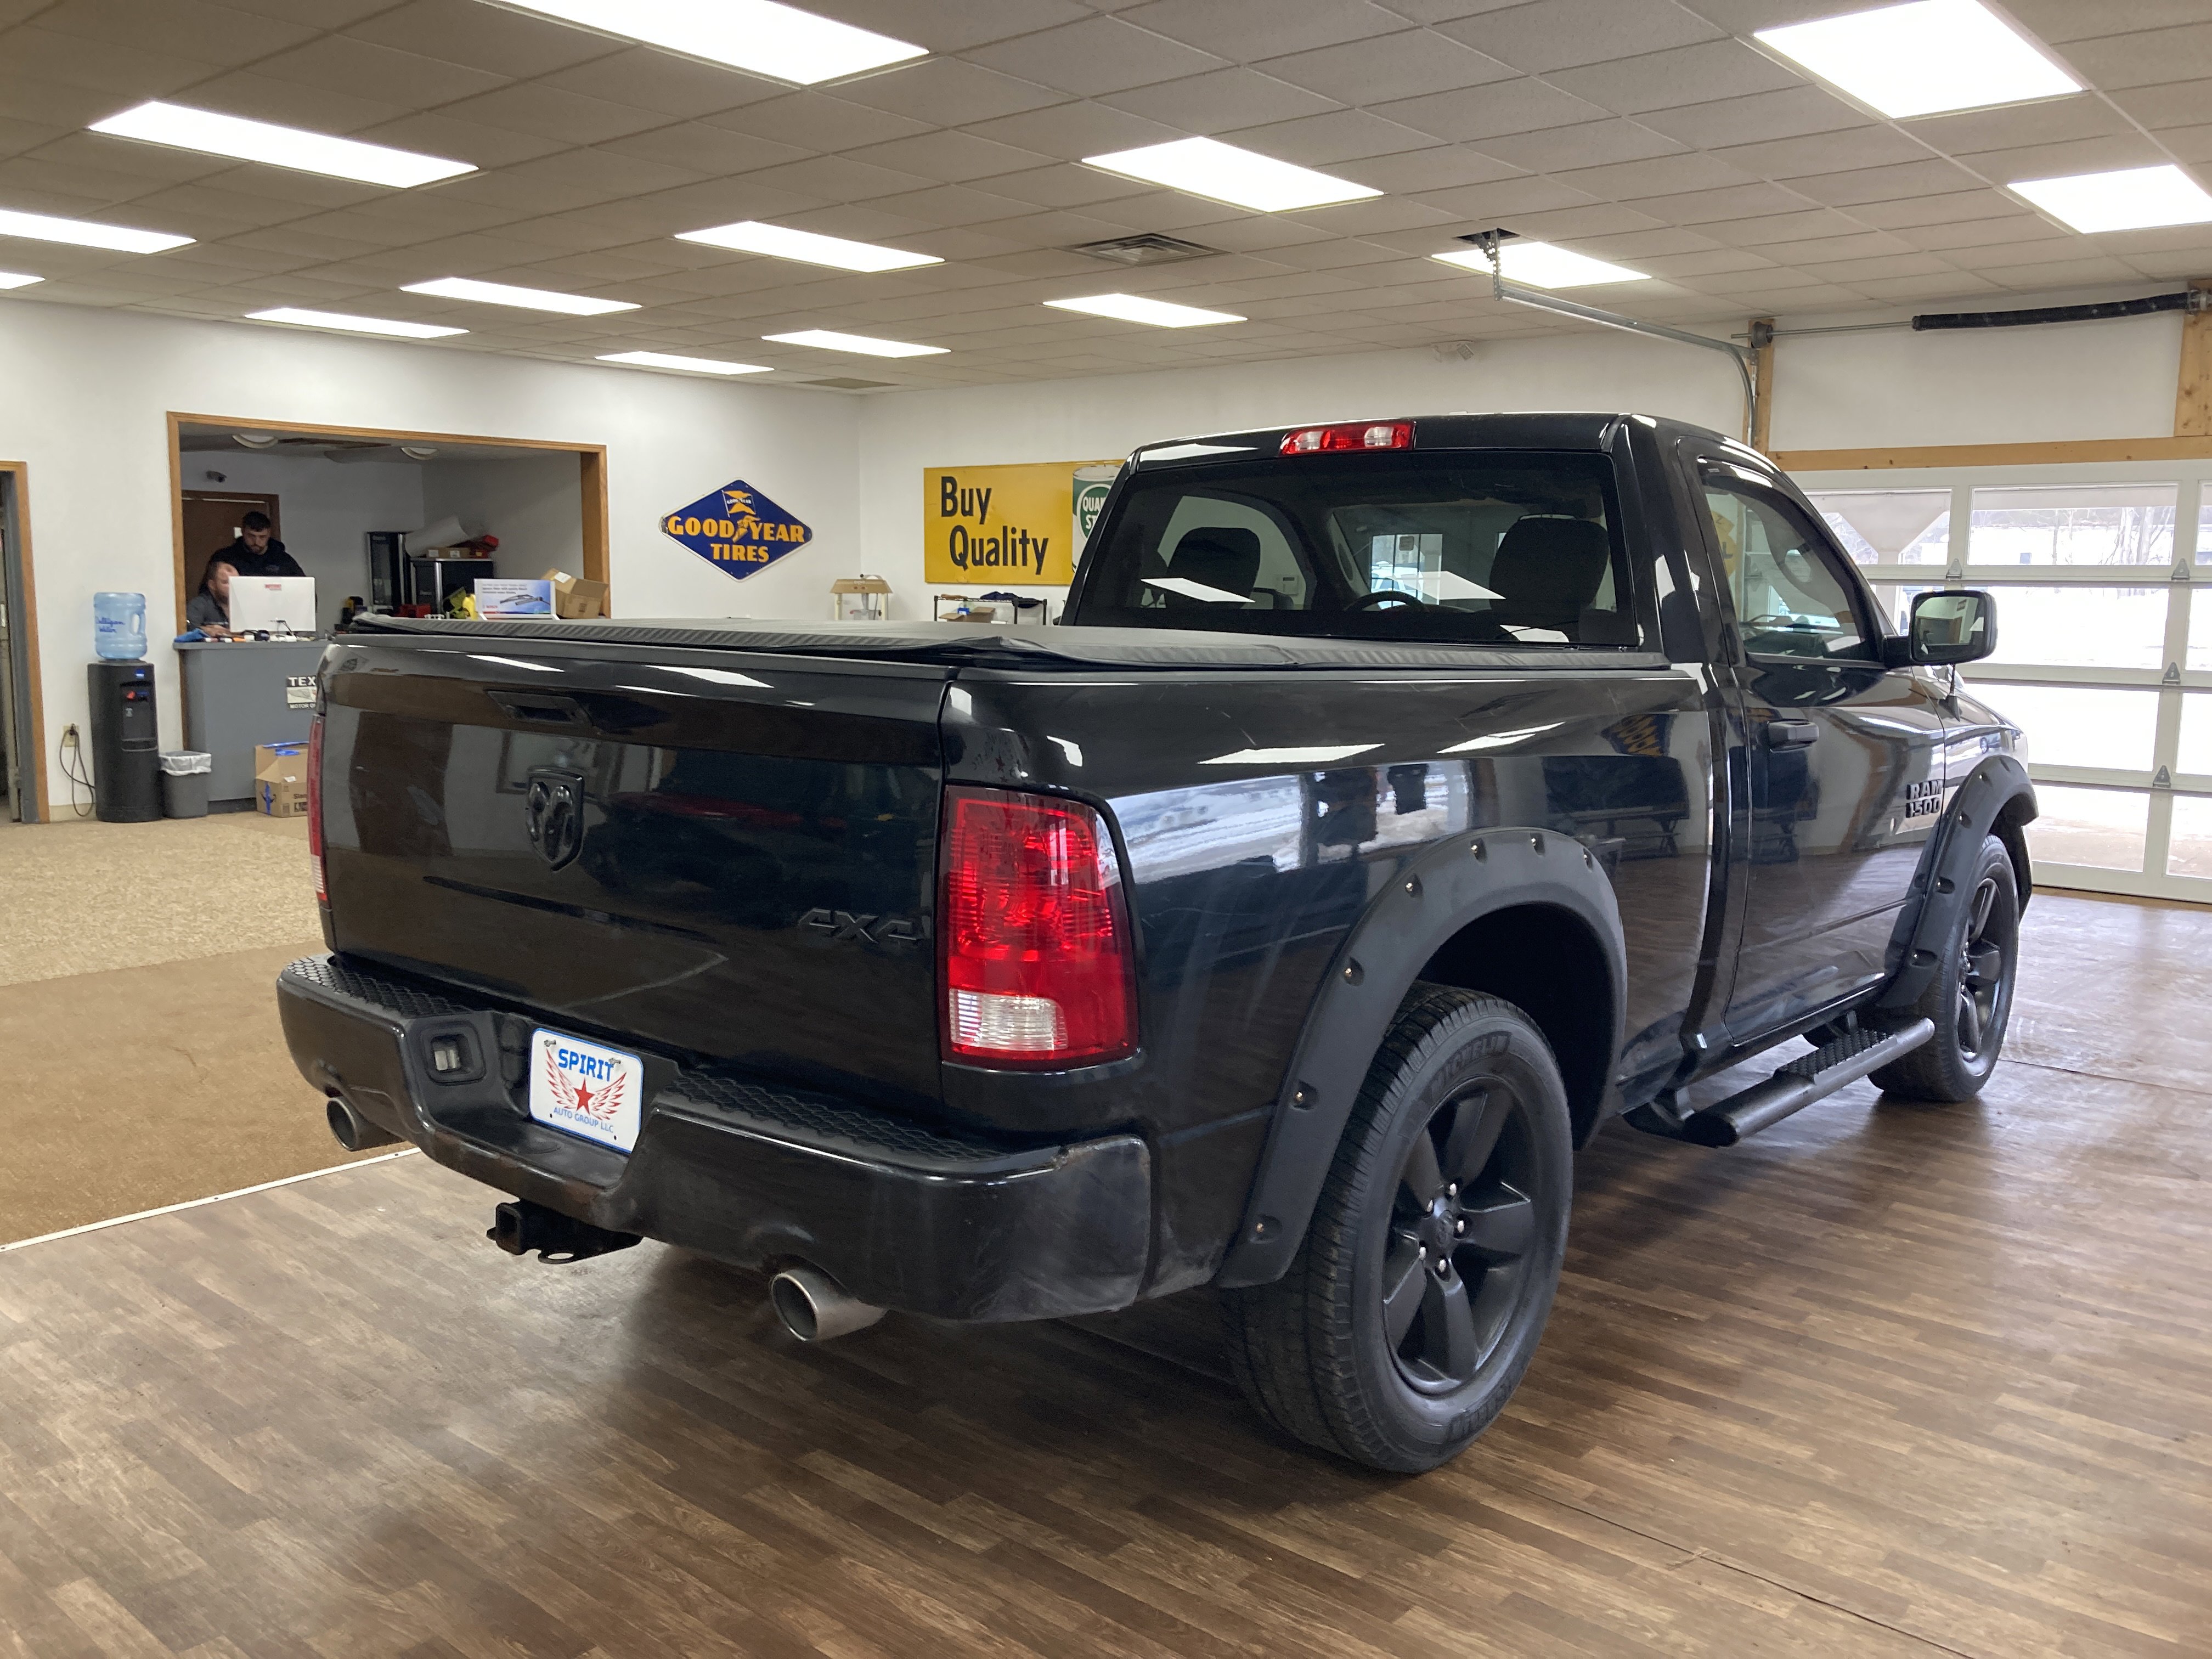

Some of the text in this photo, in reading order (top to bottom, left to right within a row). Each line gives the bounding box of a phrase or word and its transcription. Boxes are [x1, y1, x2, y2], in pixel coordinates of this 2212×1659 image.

[941, 476, 992, 524] Buy
[710, 543, 769, 563] TIRES
[949, 525, 1049, 575] Quality
[1906, 780, 1943, 800] RAM
[1906, 797, 1941, 818] 1500
[558, 1048, 614, 1082] SPIRIT
[554, 1106, 614, 1133] AUTO GROUP LLC
